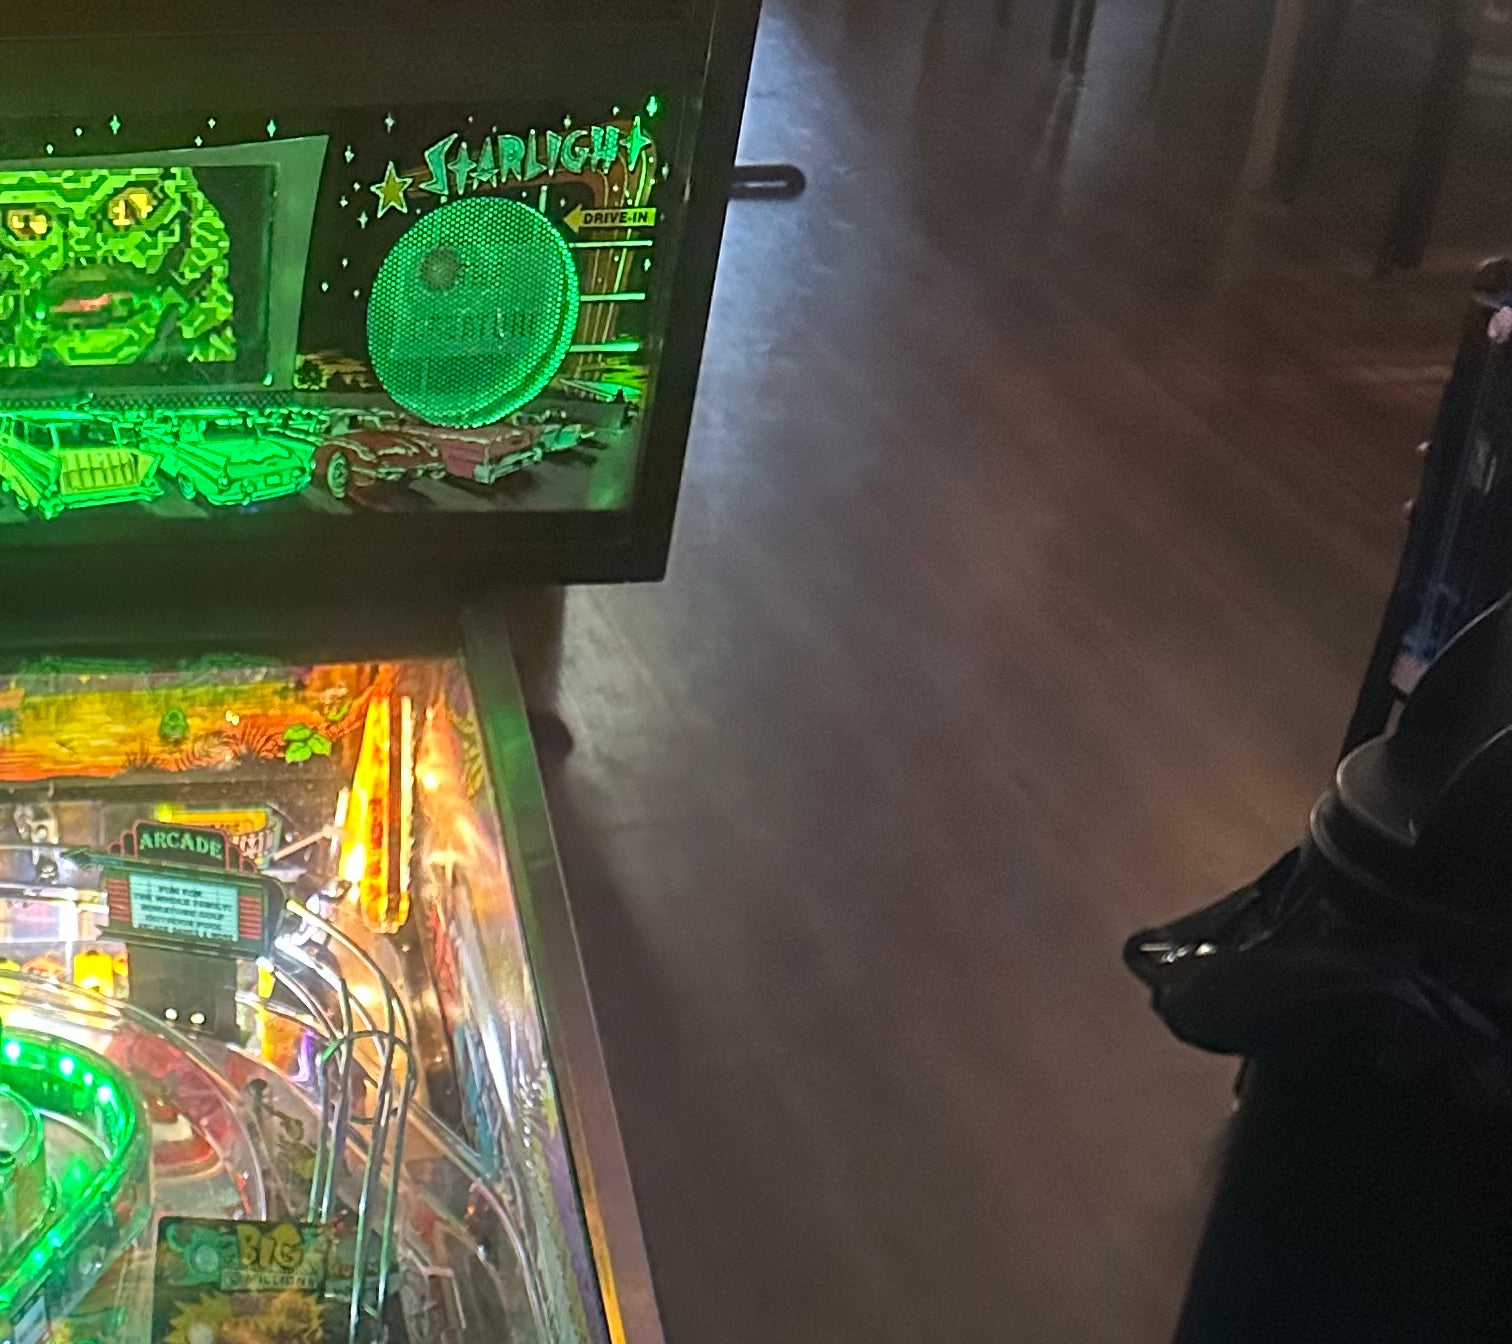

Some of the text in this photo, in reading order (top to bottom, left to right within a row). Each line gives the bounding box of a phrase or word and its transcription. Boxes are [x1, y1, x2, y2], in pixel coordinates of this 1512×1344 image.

[419, 115, 652, 196] STARLIGHT
[583, 209, 648, 225] DRIVE-IN
[139, 830, 223, 860] ARCADE
[237, 1221, 305, 1271] BIG
